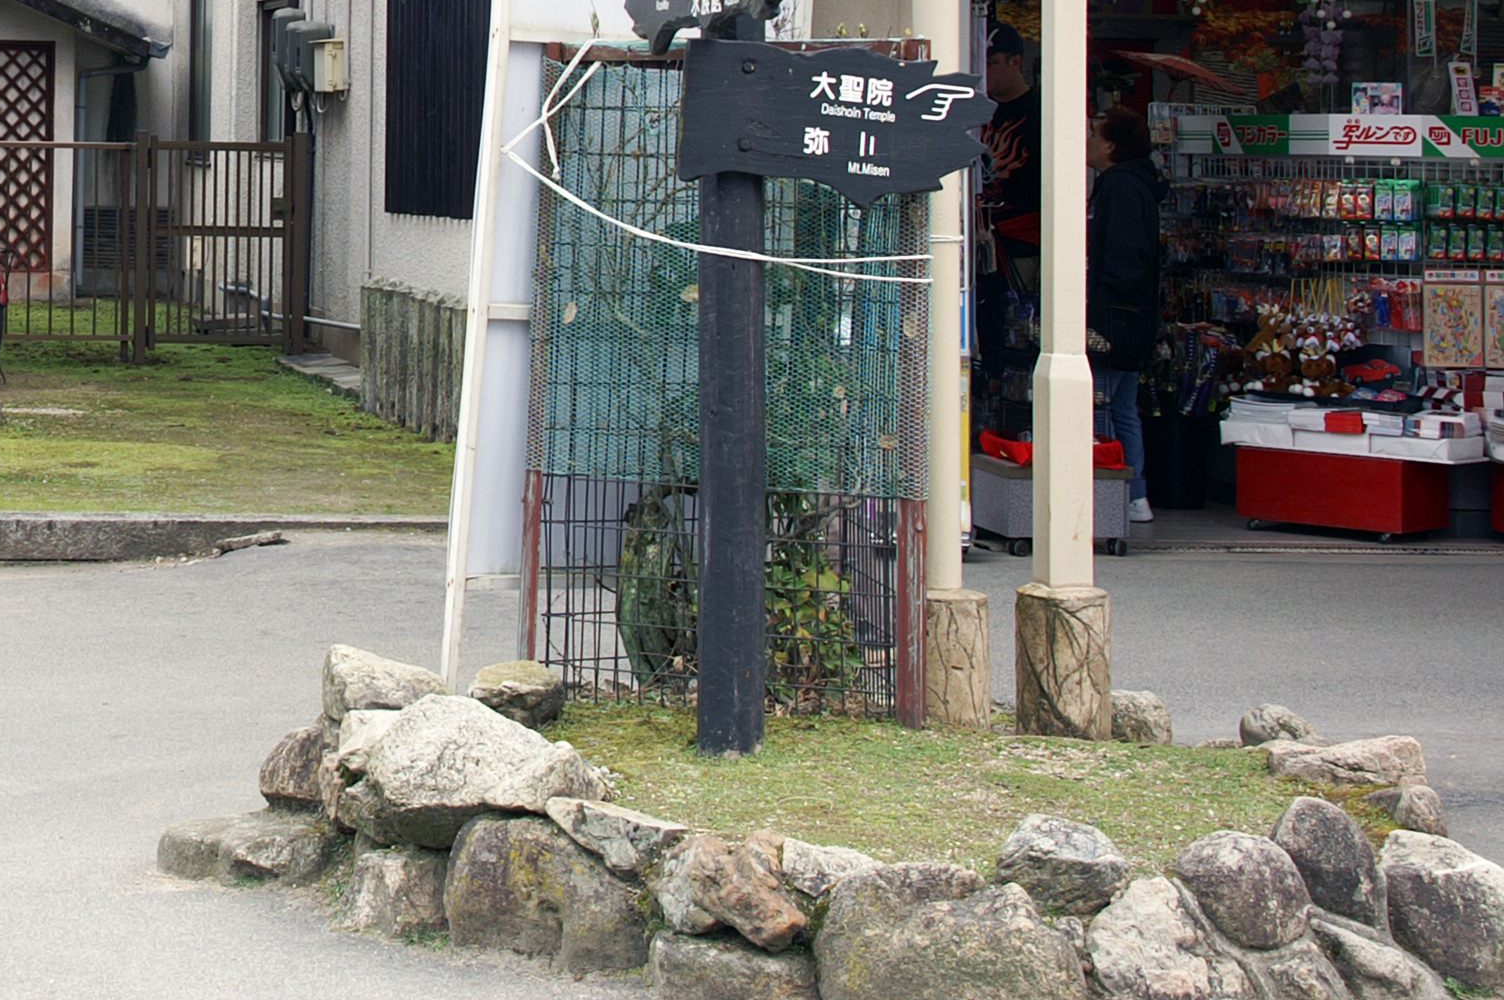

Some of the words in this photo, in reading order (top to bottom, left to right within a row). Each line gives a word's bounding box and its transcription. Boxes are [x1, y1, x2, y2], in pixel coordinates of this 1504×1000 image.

[809, 71, 894, 107] 大聖院
[821, 103, 861, 118] Daishoin
[863, 107, 896, 122] Temple
[1236, 125, 1288, 145] フジカラー
[1333, 125, 1417, 150] 写ルンです
